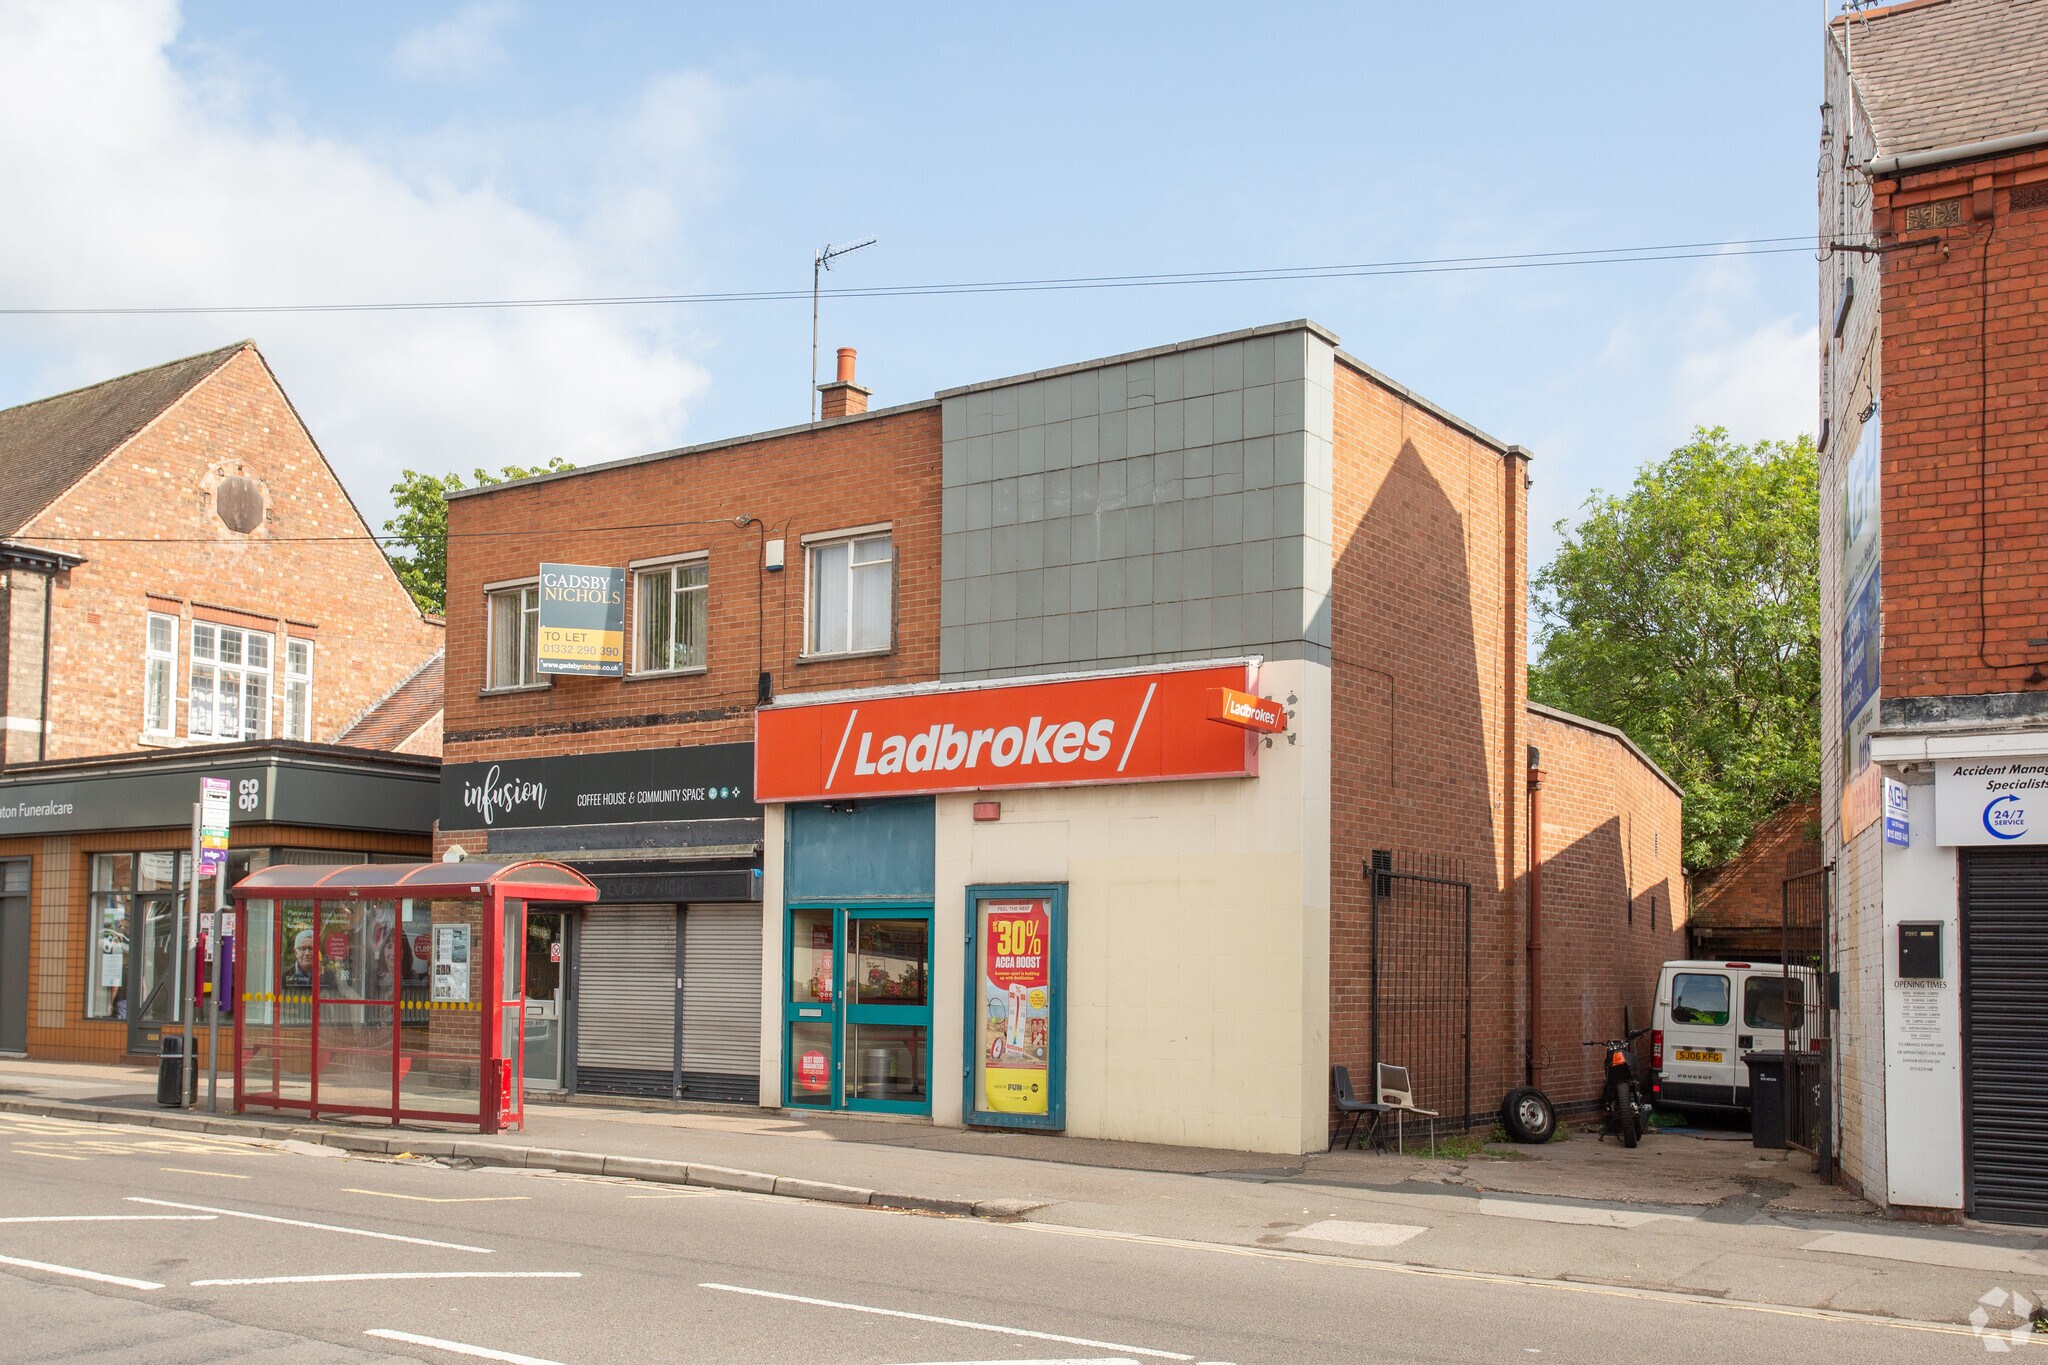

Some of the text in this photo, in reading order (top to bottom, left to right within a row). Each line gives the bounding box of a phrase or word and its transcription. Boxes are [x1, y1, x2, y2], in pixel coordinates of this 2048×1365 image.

[1843, 423, 1876, 566] AGH
[544, 573, 610, 589] GADSBY
[545, 587, 621, 605] NICHOLS
[544, 632, 588, 643] TO LET
[543, 643, 619, 656] 01332 290 390
[1230, 700, 1275, 724] Ladbrokes
[854, 716, 1115, 776] Ladbrokes
[1953, 764, 2007, 776] Accident
[1986, 779, 2048, 793] Specialists
[464, 765, 548, 825] infusion
[577, 787, 705, 807] COFFEE HOUSE & COMMUNITY SPACE
[1888, 784, 1909, 810] AGH
[19, 800, 74, 817] Funeralcare
[1994, 809, 2024, 819] 24/7
[607, 879, 693, 896] EVERY NIGHT
[997, 920, 1041, 955] 30%
[995, 956, 1041, 968] ACCA BOOST
[1894, 980, 1947, 988] OPENING TIMES
[1680, 1051, 1700, 1060] SJ06
[1008, 1083, 1022, 1091] FUN
